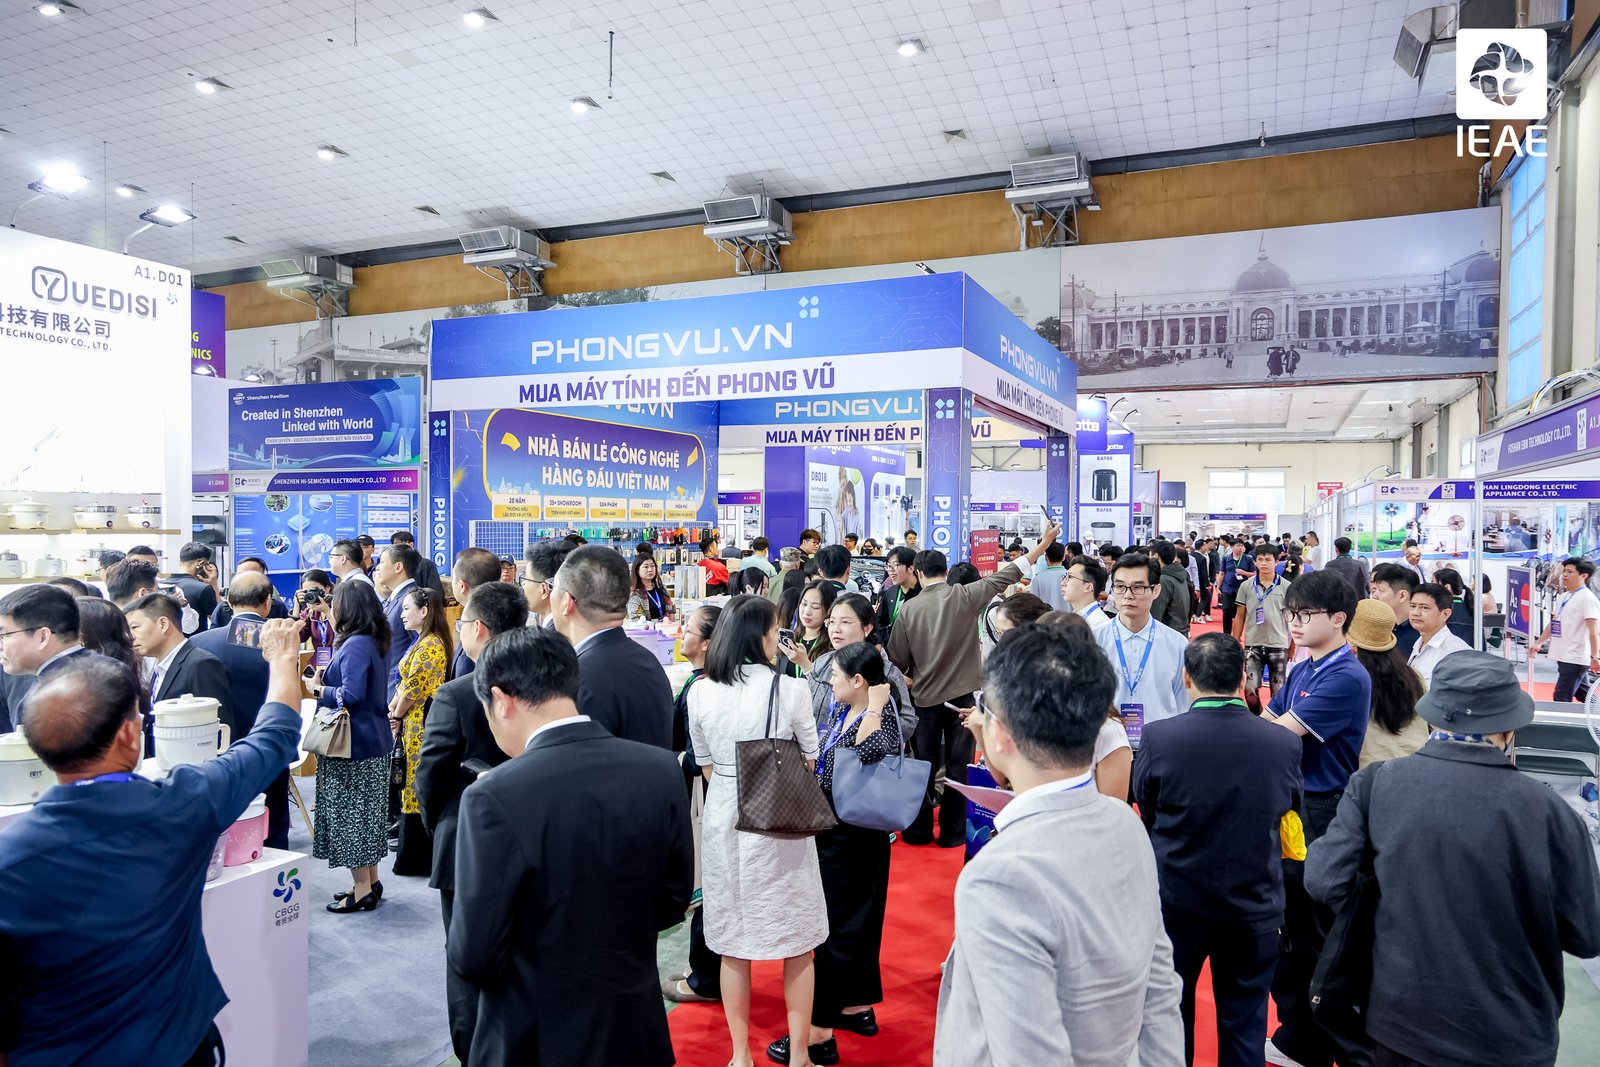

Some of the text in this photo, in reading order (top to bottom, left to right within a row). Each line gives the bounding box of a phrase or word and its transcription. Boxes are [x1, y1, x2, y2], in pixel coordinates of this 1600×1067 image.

[134, 265, 183, 286] A1.D01
[531, 322, 793, 365] PHONGVU.VN
[1000, 334, 1058, 392] PHONGVU.VN
[519, 361, 836, 404] MUA MÁY TÍNH ĐẾN PHONG VŨ
[996, 377, 1011, 402] MUA
[1011, 383, 1024, 408] MÁY
[241, 406, 343, 421] Created in Shenzhen
[282, 417, 373, 433] Linked with World
[766, 431, 798, 444] MUA
[801, 426, 833, 443] MÁY
[835, 426, 870, 442] TÍNH
[874, 422, 906, 441] ĐẾN
[1529, 430, 1553, 447] TECHNOLOGY
[527, 434, 680, 472] NHÀ BÁN LẺ CÔNG NGHỆ
[301, 477, 331, 485] HI-SEMICON
[541, 462, 670, 494] HÀNG ĐẦU VIỆT NAM
[433, 497, 446, 567] PHONG
[275, 902, 300, 919] CBGG
